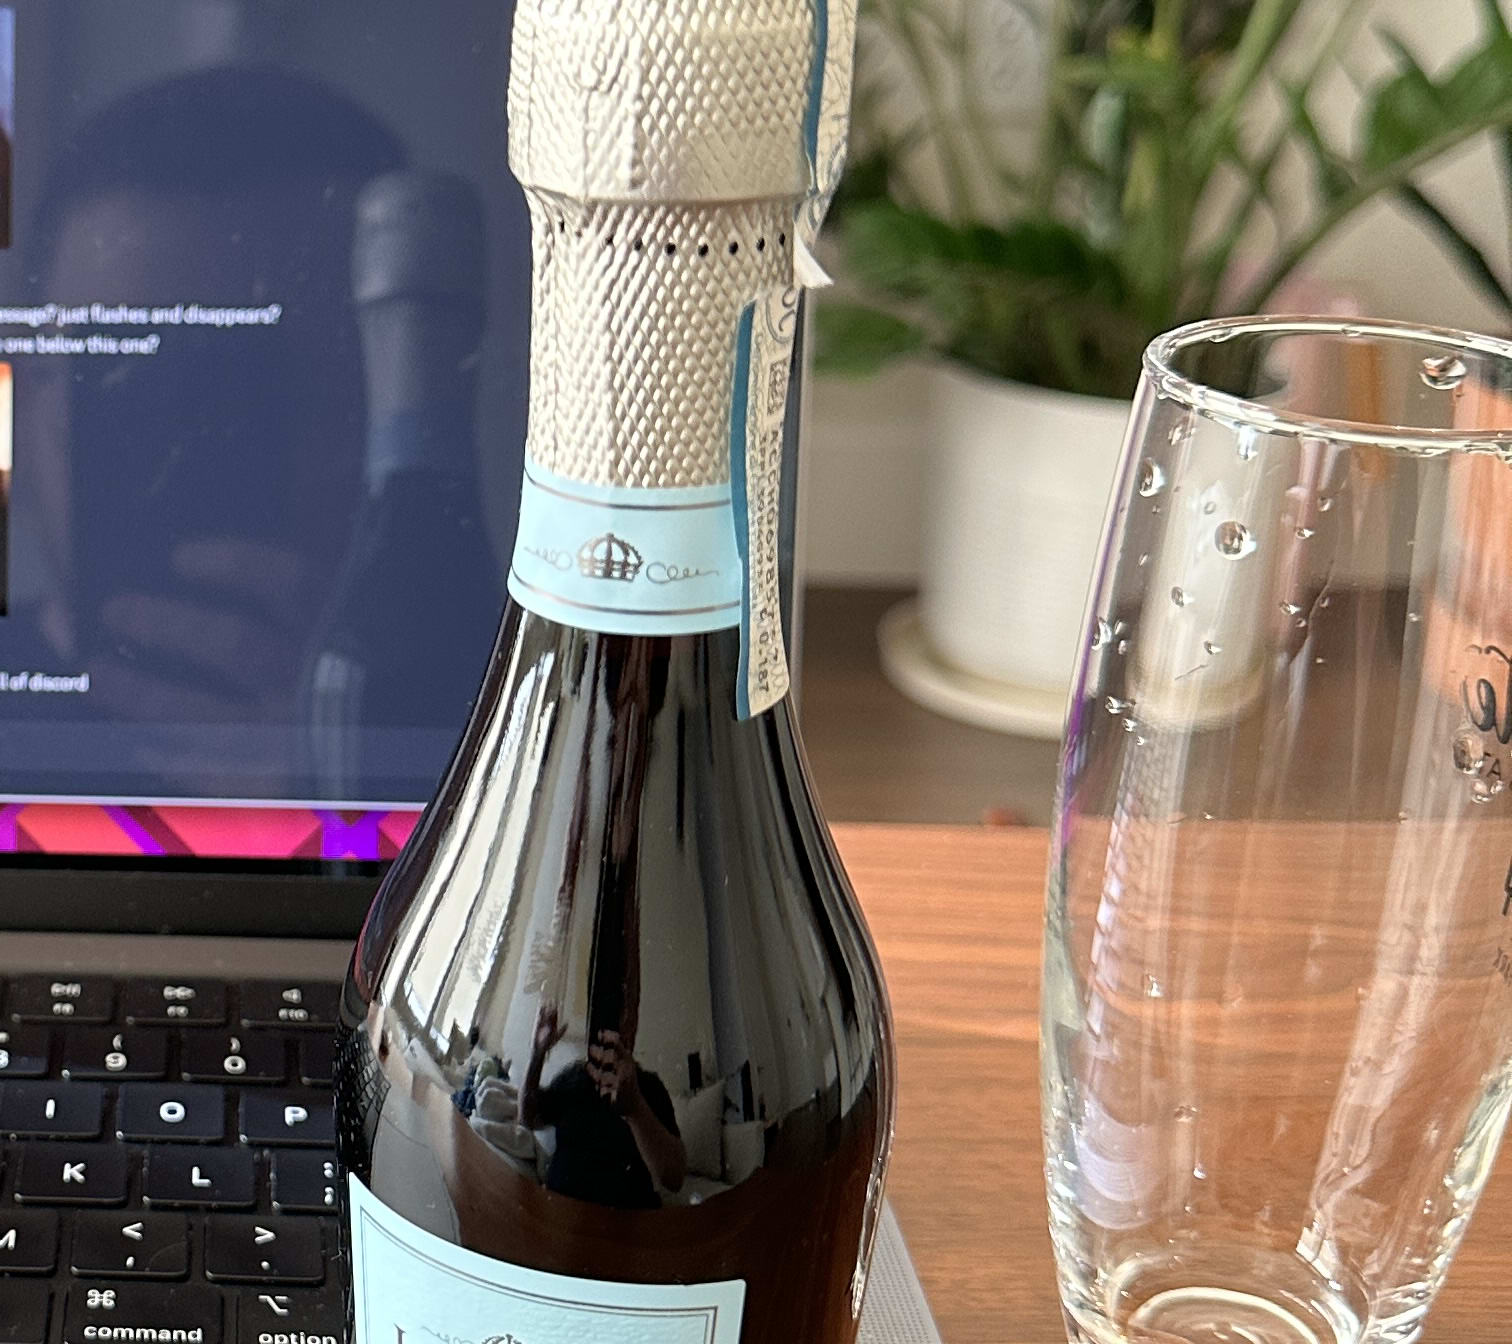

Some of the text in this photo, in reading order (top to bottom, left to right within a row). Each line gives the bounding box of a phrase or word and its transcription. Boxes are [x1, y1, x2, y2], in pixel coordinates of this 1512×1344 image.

[57, 304, 89, 328] just
[90, 303, 148, 326] flashes
[149, 303, 183, 326] and
[3, 336, 35, 355] one
[35, 332, 86, 355] below
[86, 333, 118, 355] this
[118, 333, 160, 356] one?
[9, 672, 29, 692] of
[29, 672, 90, 693] discord
[105, 1052, 127, 1071] 9
[223, 1054, 246, 1074] 0
[45, 1098, 56, 1119] I
[159, 1101, 186, 1124] O
[284, 1106, 308, 1127] P
[62, 1162, 87, 1184] K
[191, 1166, 212, 1188] L
[84, 1324, 205, 1344] command
